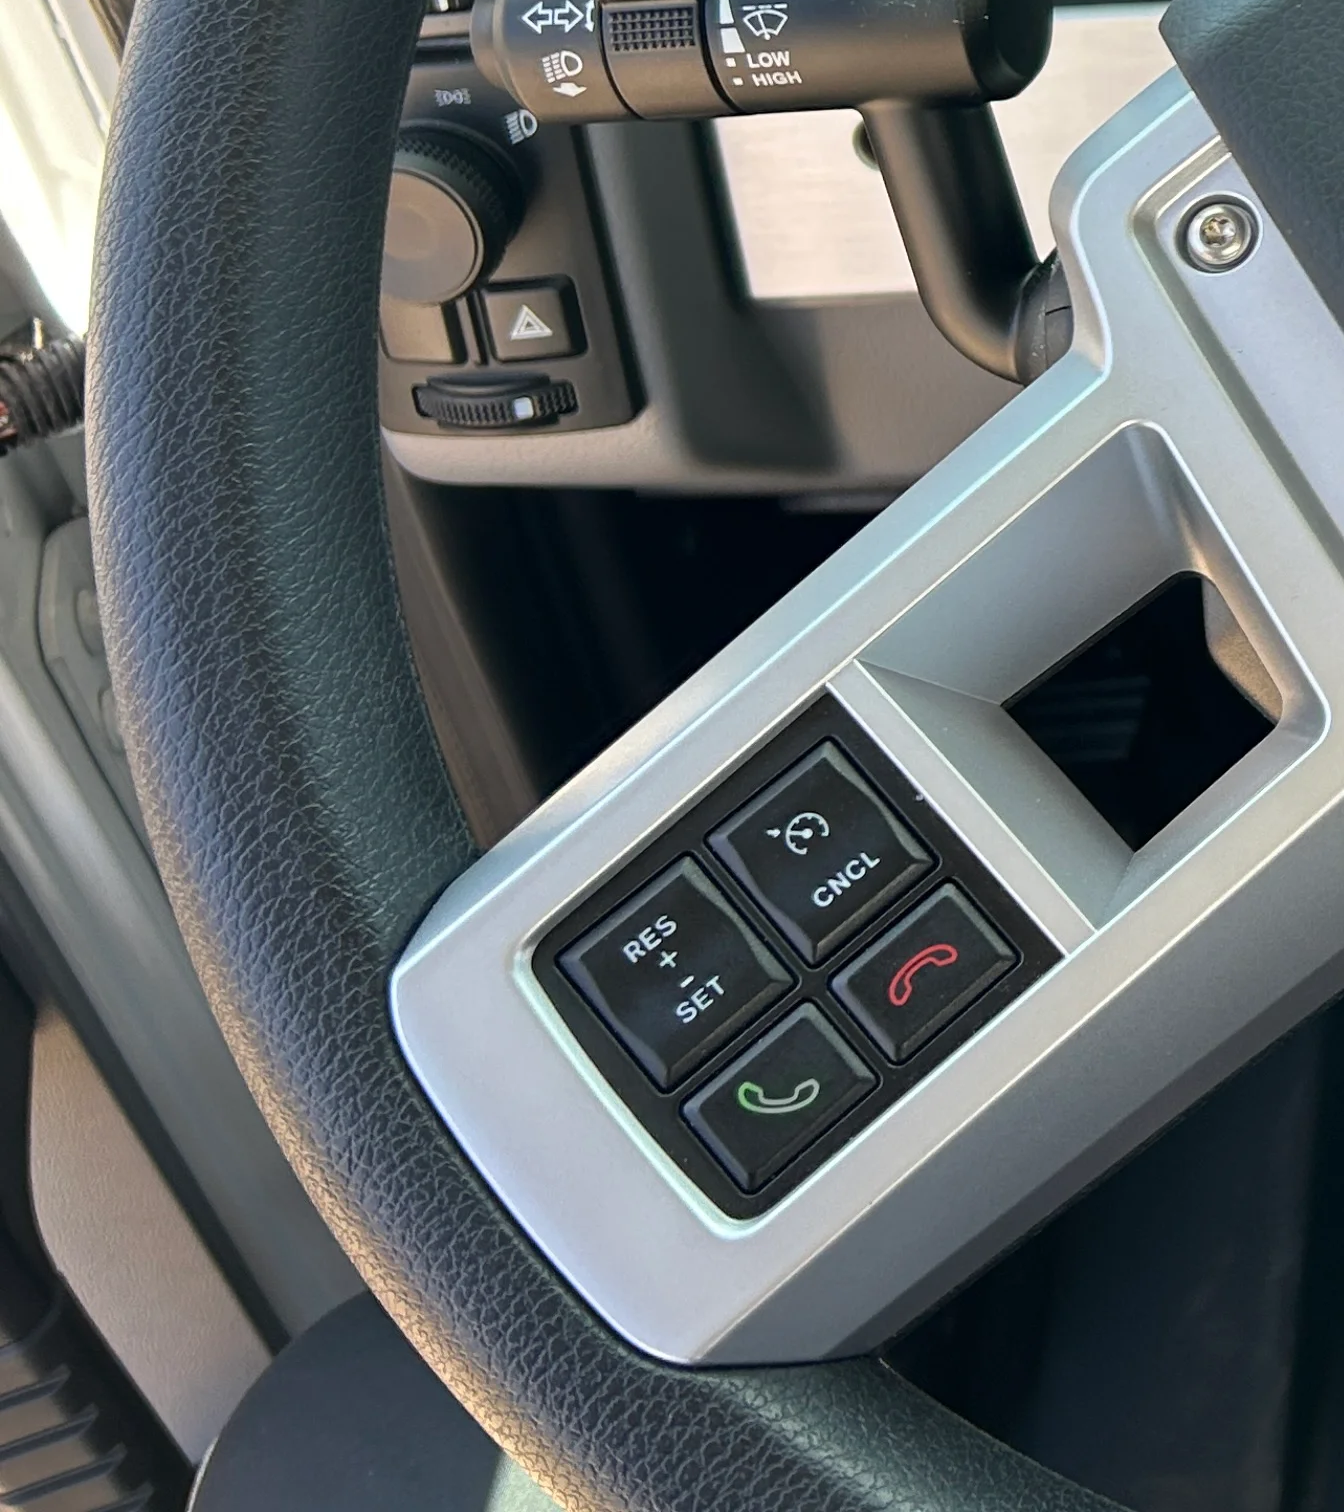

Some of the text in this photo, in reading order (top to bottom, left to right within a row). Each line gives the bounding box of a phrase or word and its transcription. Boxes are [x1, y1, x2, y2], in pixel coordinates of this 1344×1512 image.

[746, 51, 790, 69] LOW
[752, 70, 802, 87] HIGH
[811, 851, 880, 908] CNCL
[621, 914, 678, 964] RES
[675, 975, 727, 1024] SET
